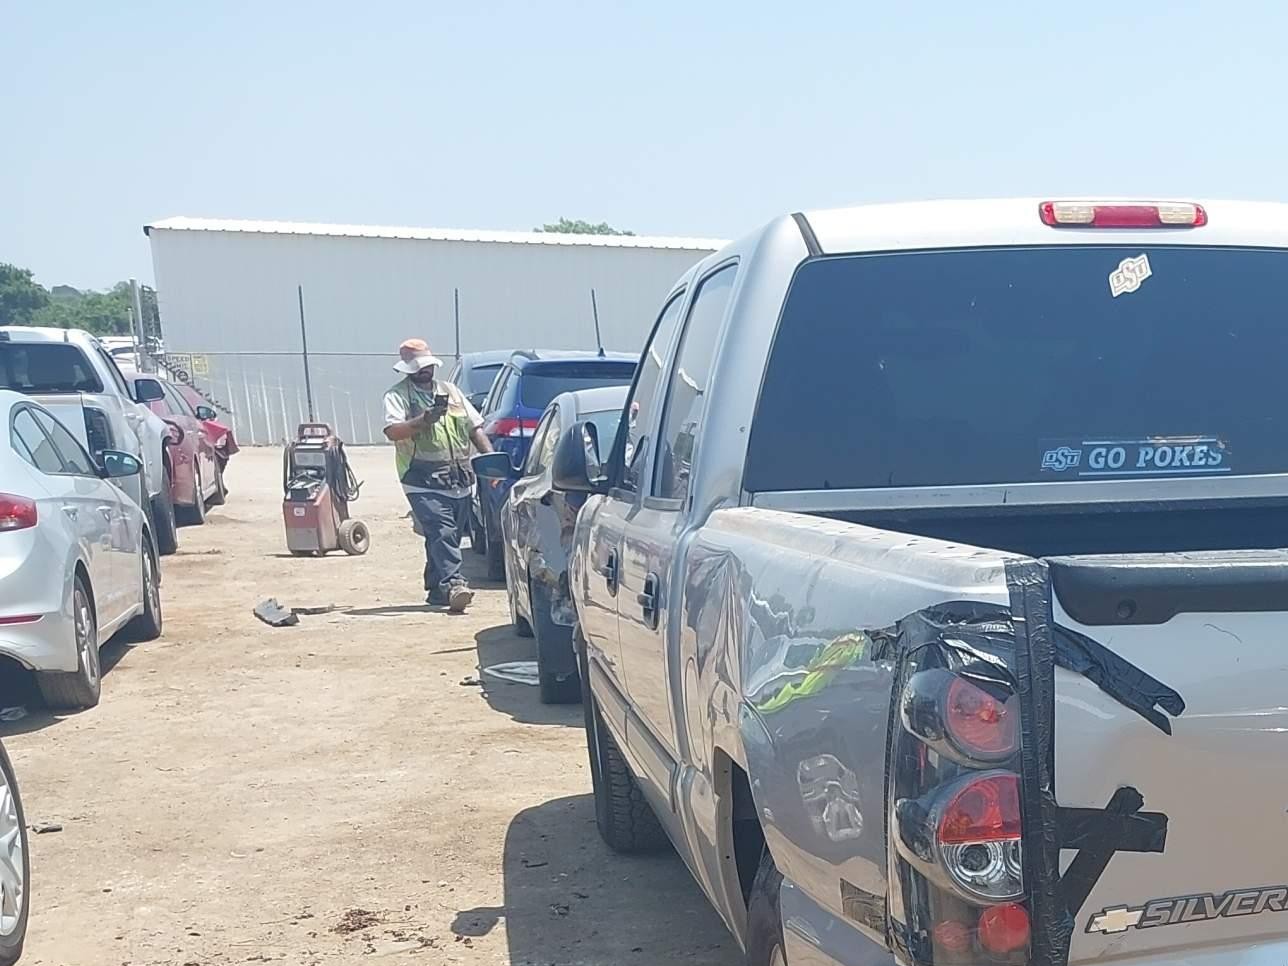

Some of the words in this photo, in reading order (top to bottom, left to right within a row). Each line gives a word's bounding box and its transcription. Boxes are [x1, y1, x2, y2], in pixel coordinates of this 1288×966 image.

[1110, 256, 1149, 294] OSU
[1042, 447, 1081, 471] OSU
[1088, 446, 1126, 469] GO
[1136, 445, 1222, 468] POKES
